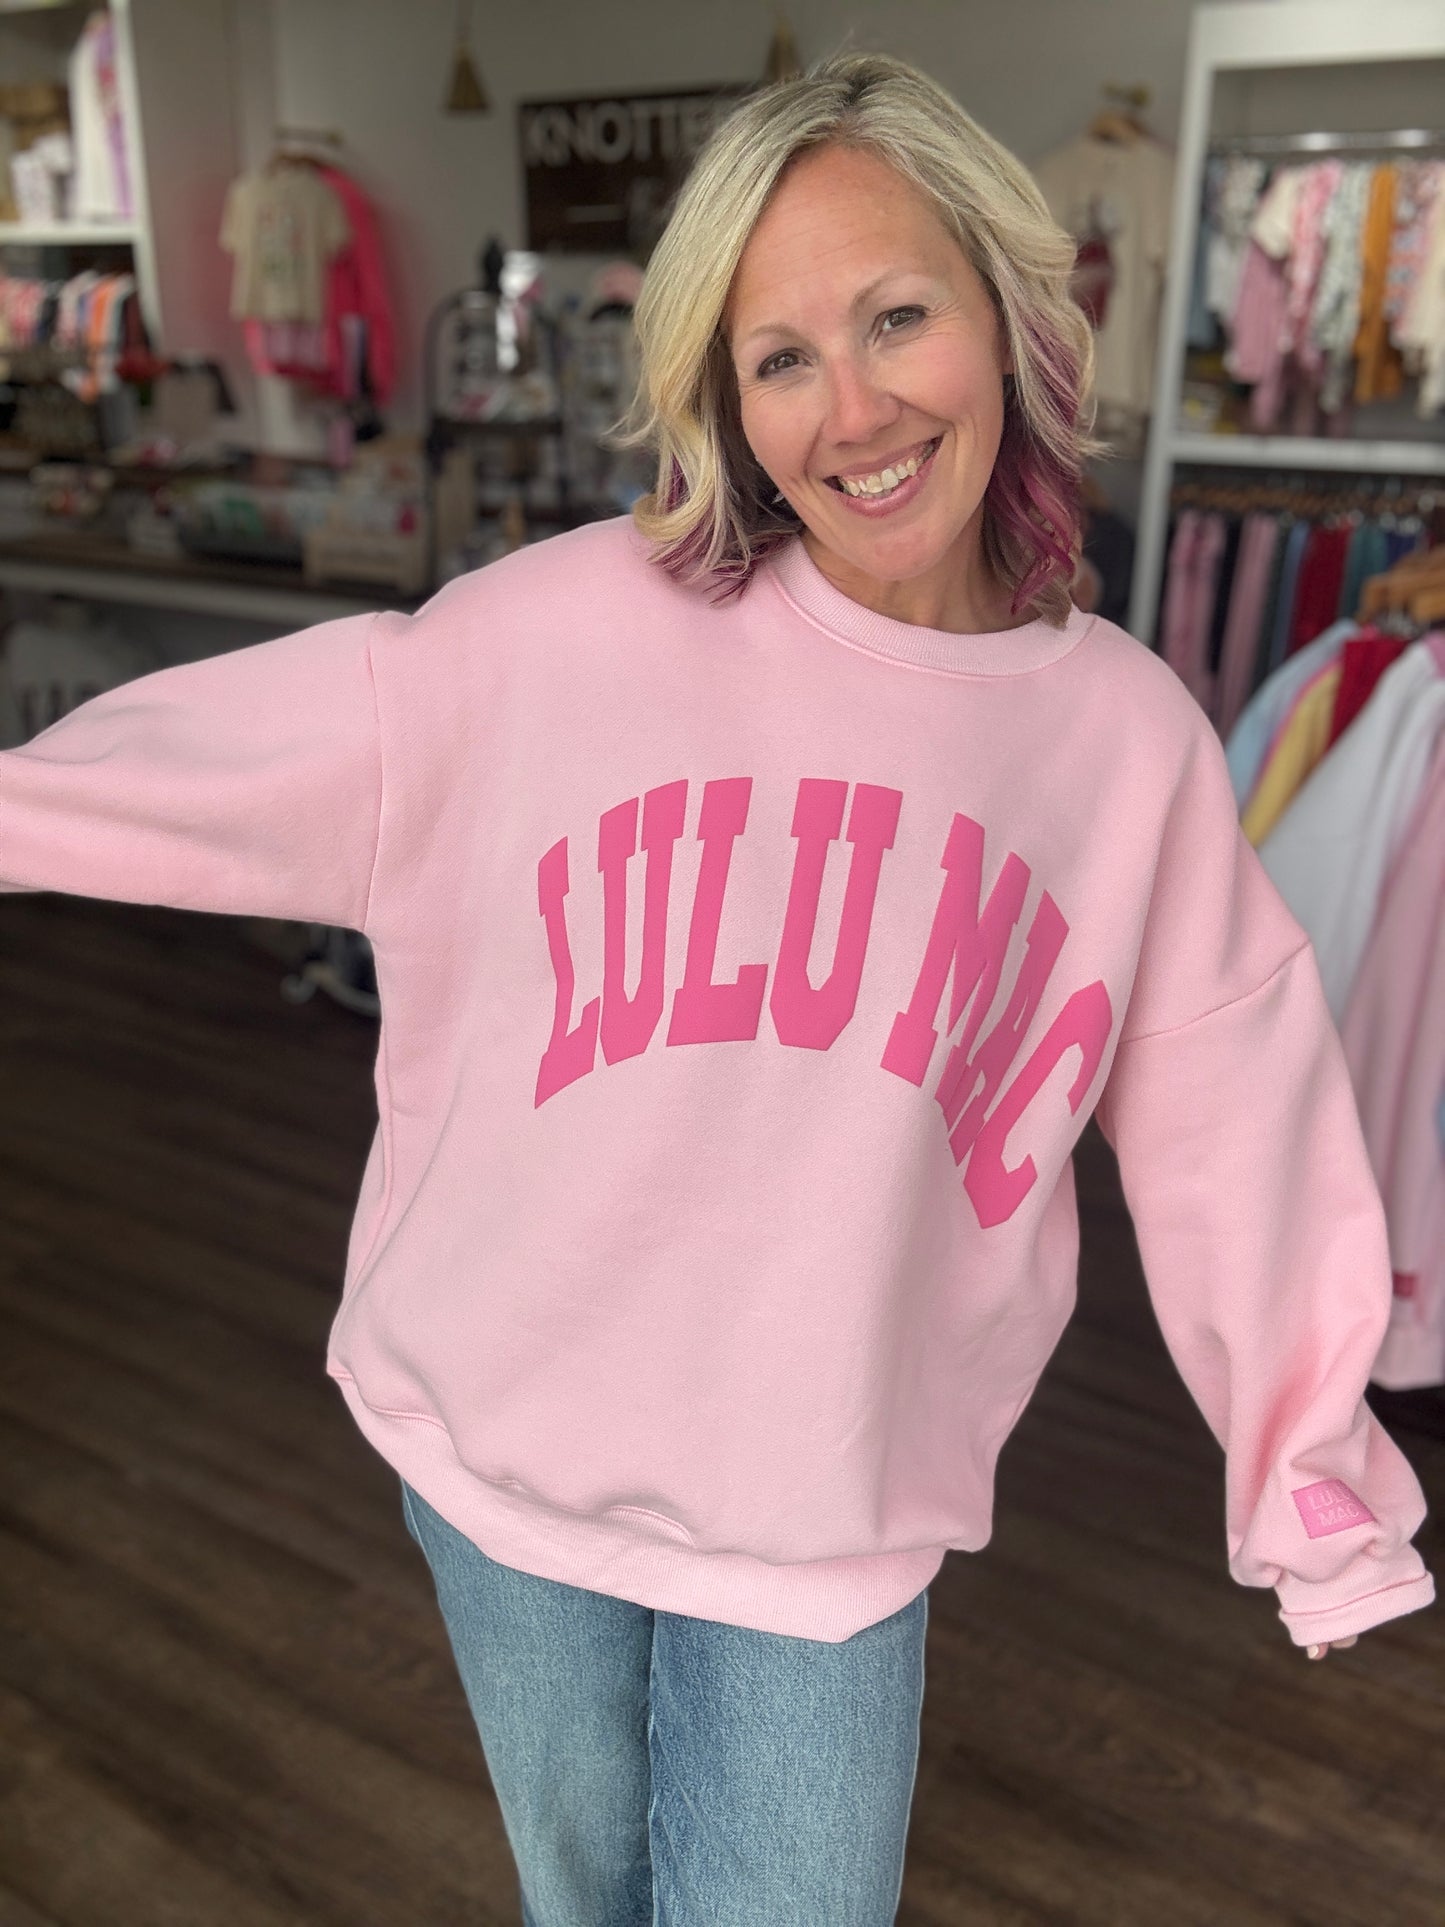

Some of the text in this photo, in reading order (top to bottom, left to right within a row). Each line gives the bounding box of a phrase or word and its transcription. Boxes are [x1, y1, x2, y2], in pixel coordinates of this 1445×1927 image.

[534, 777, 1112, 1229] LULU MAC
[1318, 1502, 1360, 1527] MAC
